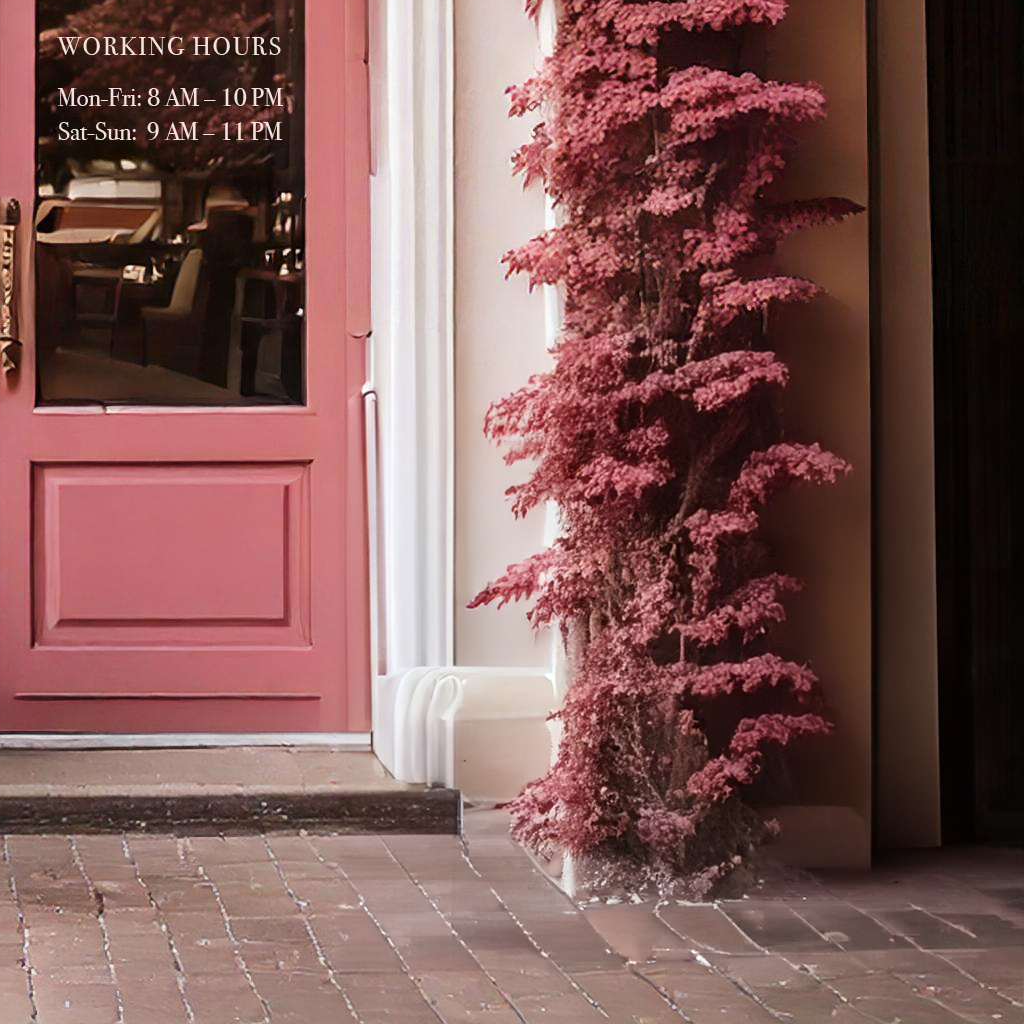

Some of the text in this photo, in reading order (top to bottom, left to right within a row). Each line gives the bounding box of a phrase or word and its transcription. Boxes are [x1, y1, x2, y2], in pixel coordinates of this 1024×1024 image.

[57, 36, 282, 56] WORKING HOURS
[57, 87, 142, 107] Mon-Fri:
[147, 87, 161, 107] 8
[164, 87, 200, 107] AM
[222, 87, 247, 107] 10
[250, 87, 284, 107] PM
[58, 121, 137, 141] Sat-Sun:
[146, 121, 160, 141] 9
[164, 121, 199, 141] AM
[222, 121, 245, 141] 11
[250, 121, 283, 141] PM
